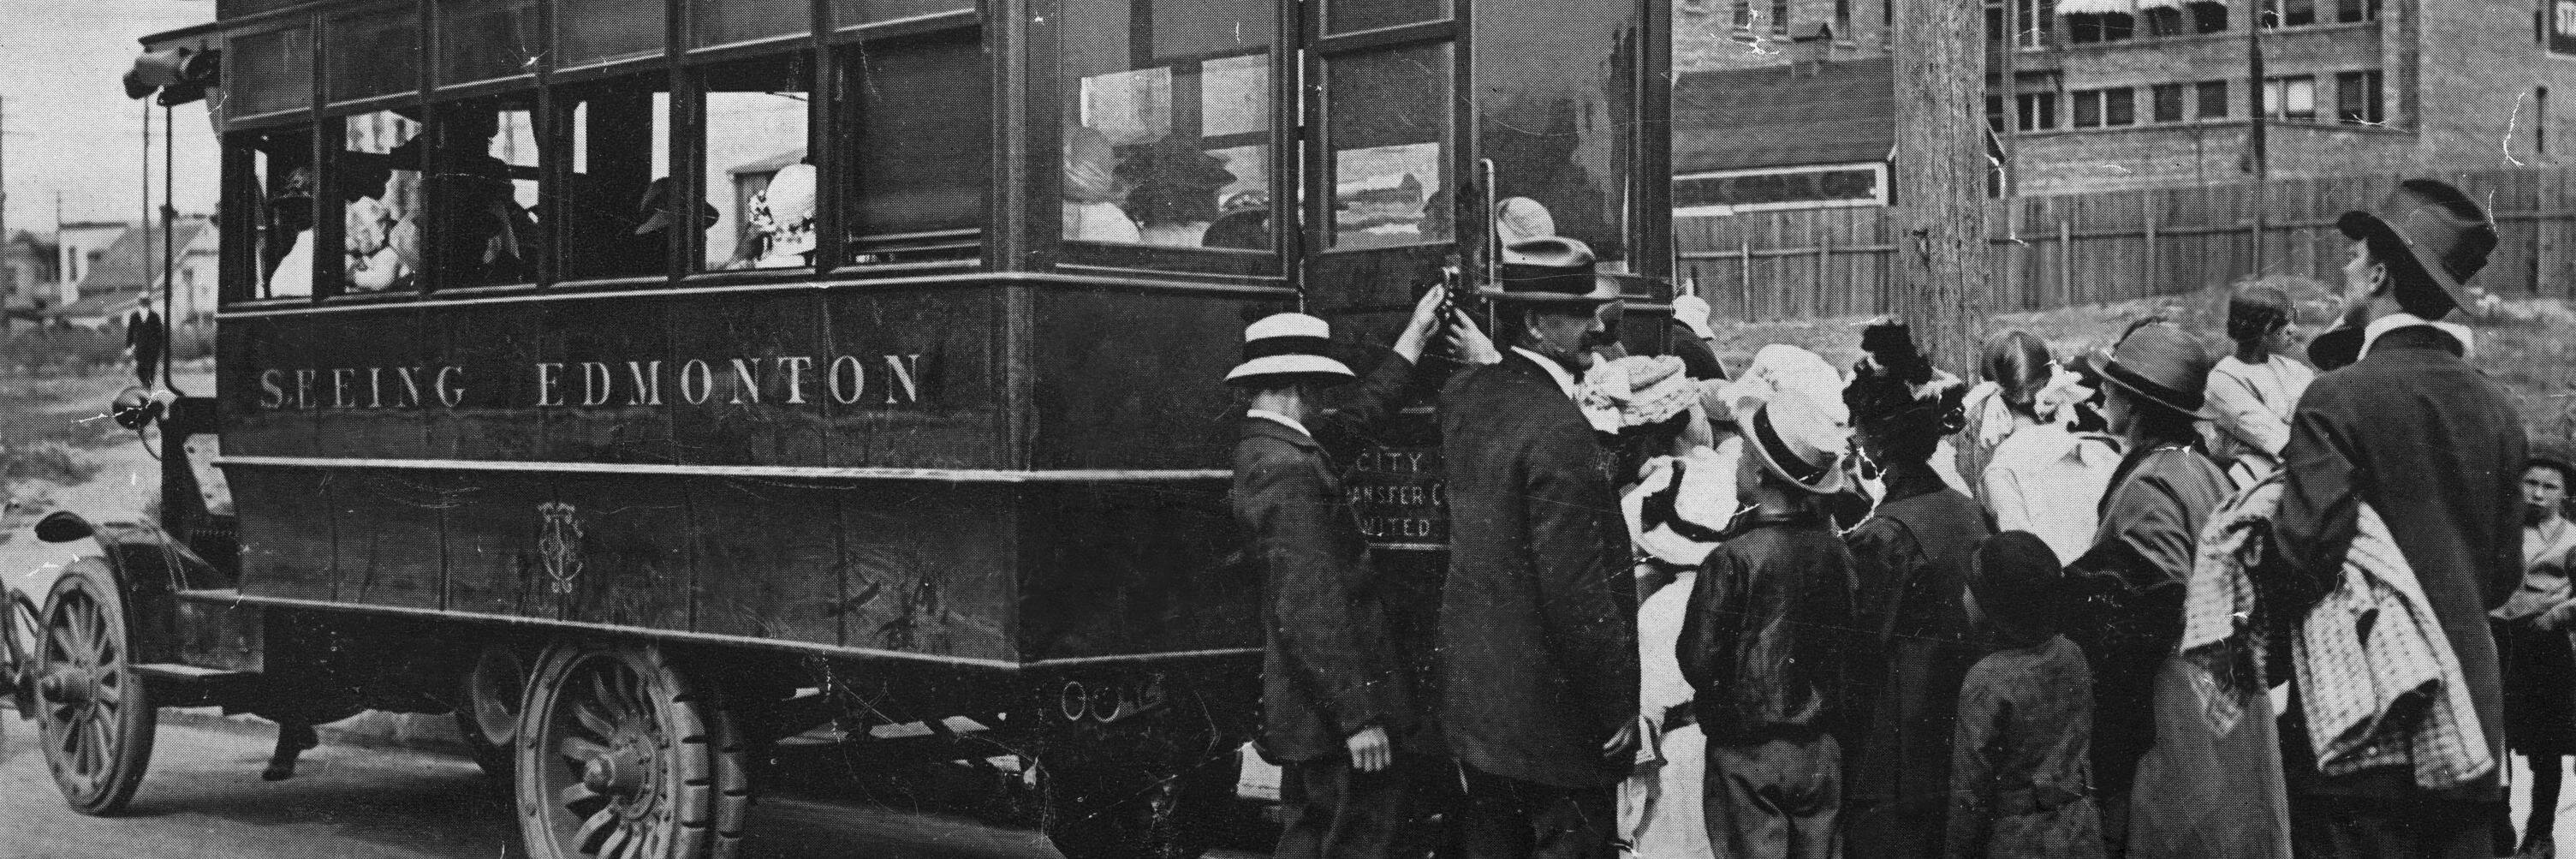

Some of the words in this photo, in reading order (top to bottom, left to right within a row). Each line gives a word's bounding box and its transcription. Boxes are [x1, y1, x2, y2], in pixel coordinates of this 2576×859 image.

[260, 367, 465, 409] SEEING
[536, 355, 920, 406] EDMONTON
[1356, 451, 1423, 472] CITY
